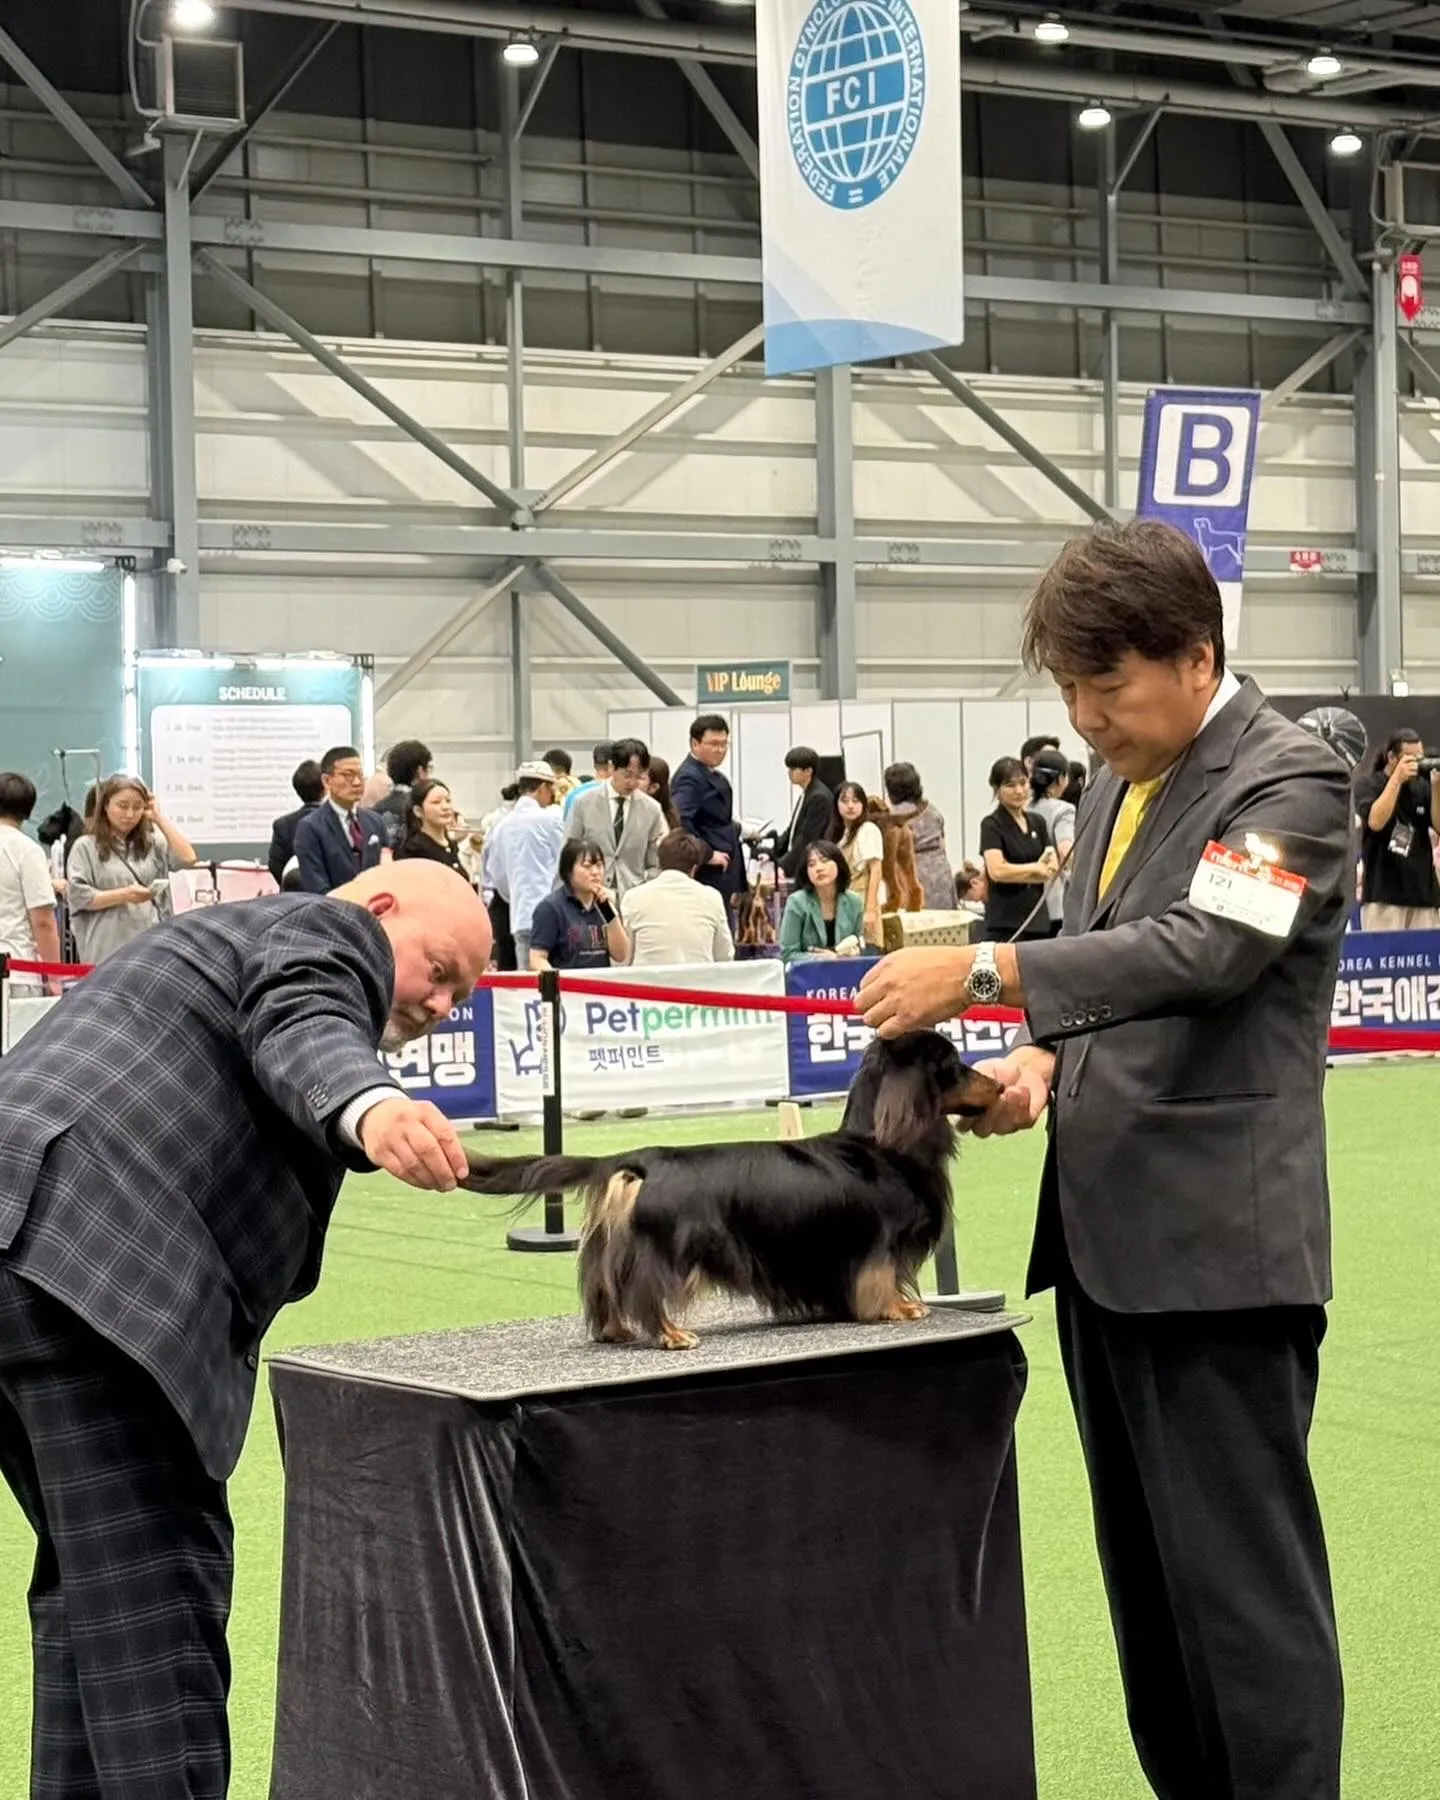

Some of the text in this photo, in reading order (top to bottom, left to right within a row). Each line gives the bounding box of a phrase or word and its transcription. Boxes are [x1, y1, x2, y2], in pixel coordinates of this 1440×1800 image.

[827, 72, 875, 114] FCI
[789, 76, 837, 201] FEDERATION
[1173, 412, 1233, 497] B
[219, 686, 287, 700] SCHEDULE
[707, 670, 781, 695] VIP Lounge
[1338, 957, 1373, 972] OREA
[1380, 953, 1431, 969] KENNEL
[448, 1007, 473, 1021] ON
[377, 1031, 476, 1088] 연맹
[588, 1044, 664, 1072] 펫퍼민트
